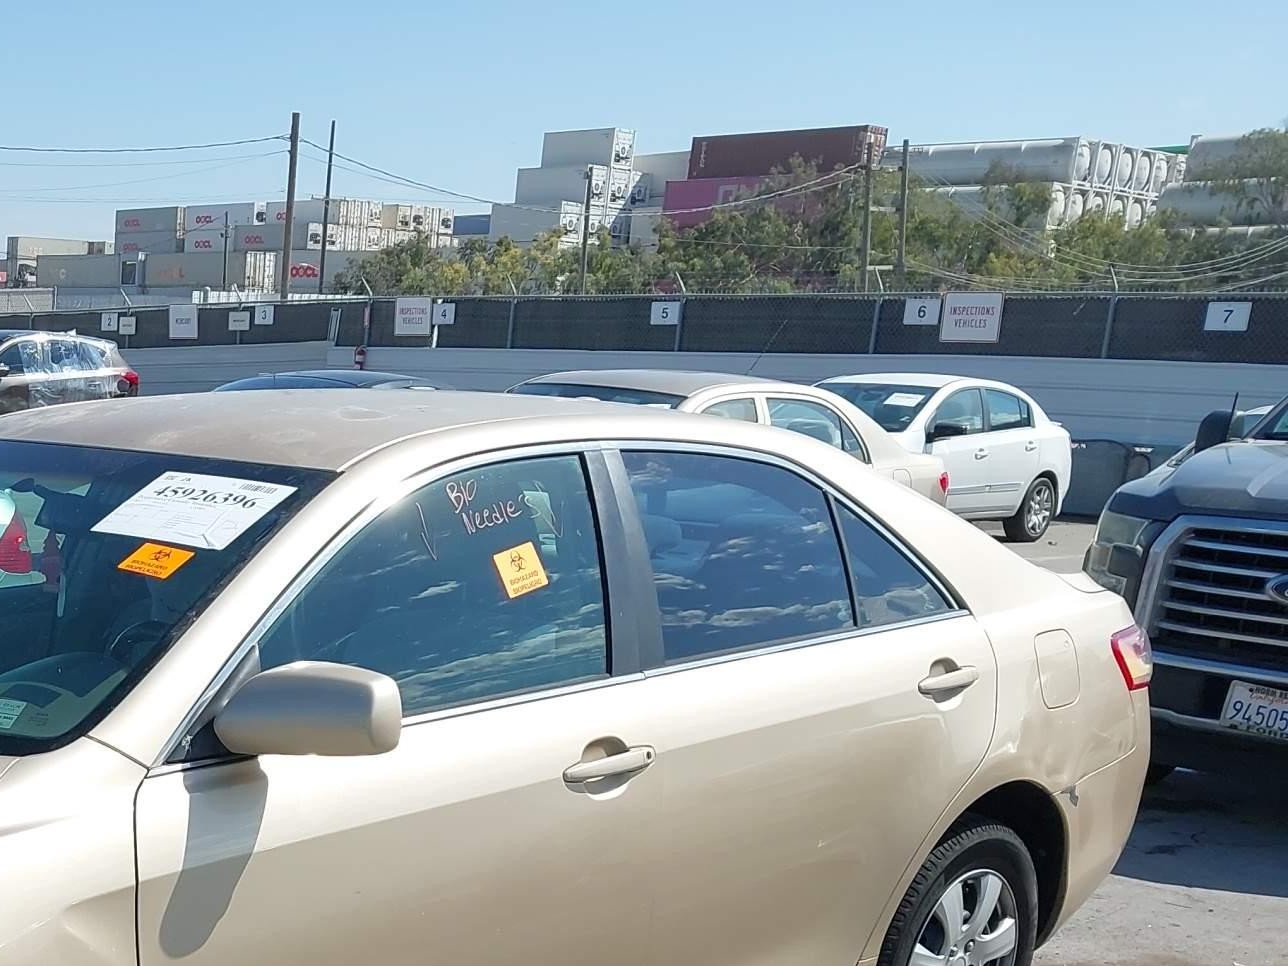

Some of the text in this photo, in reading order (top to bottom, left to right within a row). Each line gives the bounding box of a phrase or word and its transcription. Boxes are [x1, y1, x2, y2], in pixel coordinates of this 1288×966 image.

[262, 310, 267, 320] 3
[441, 308, 447, 320] 4
[661, 307, 669, 319] 5
[917, 305, 927, 319] 6
[949, 305, 995, 317] INSPECTIONS
[1223, 309, 1234, 324] 7
[107, 318, 112, 327] 2
[954, 318, 987, 329] VEHICLES
[153, 485, 262, 509] 45926396
